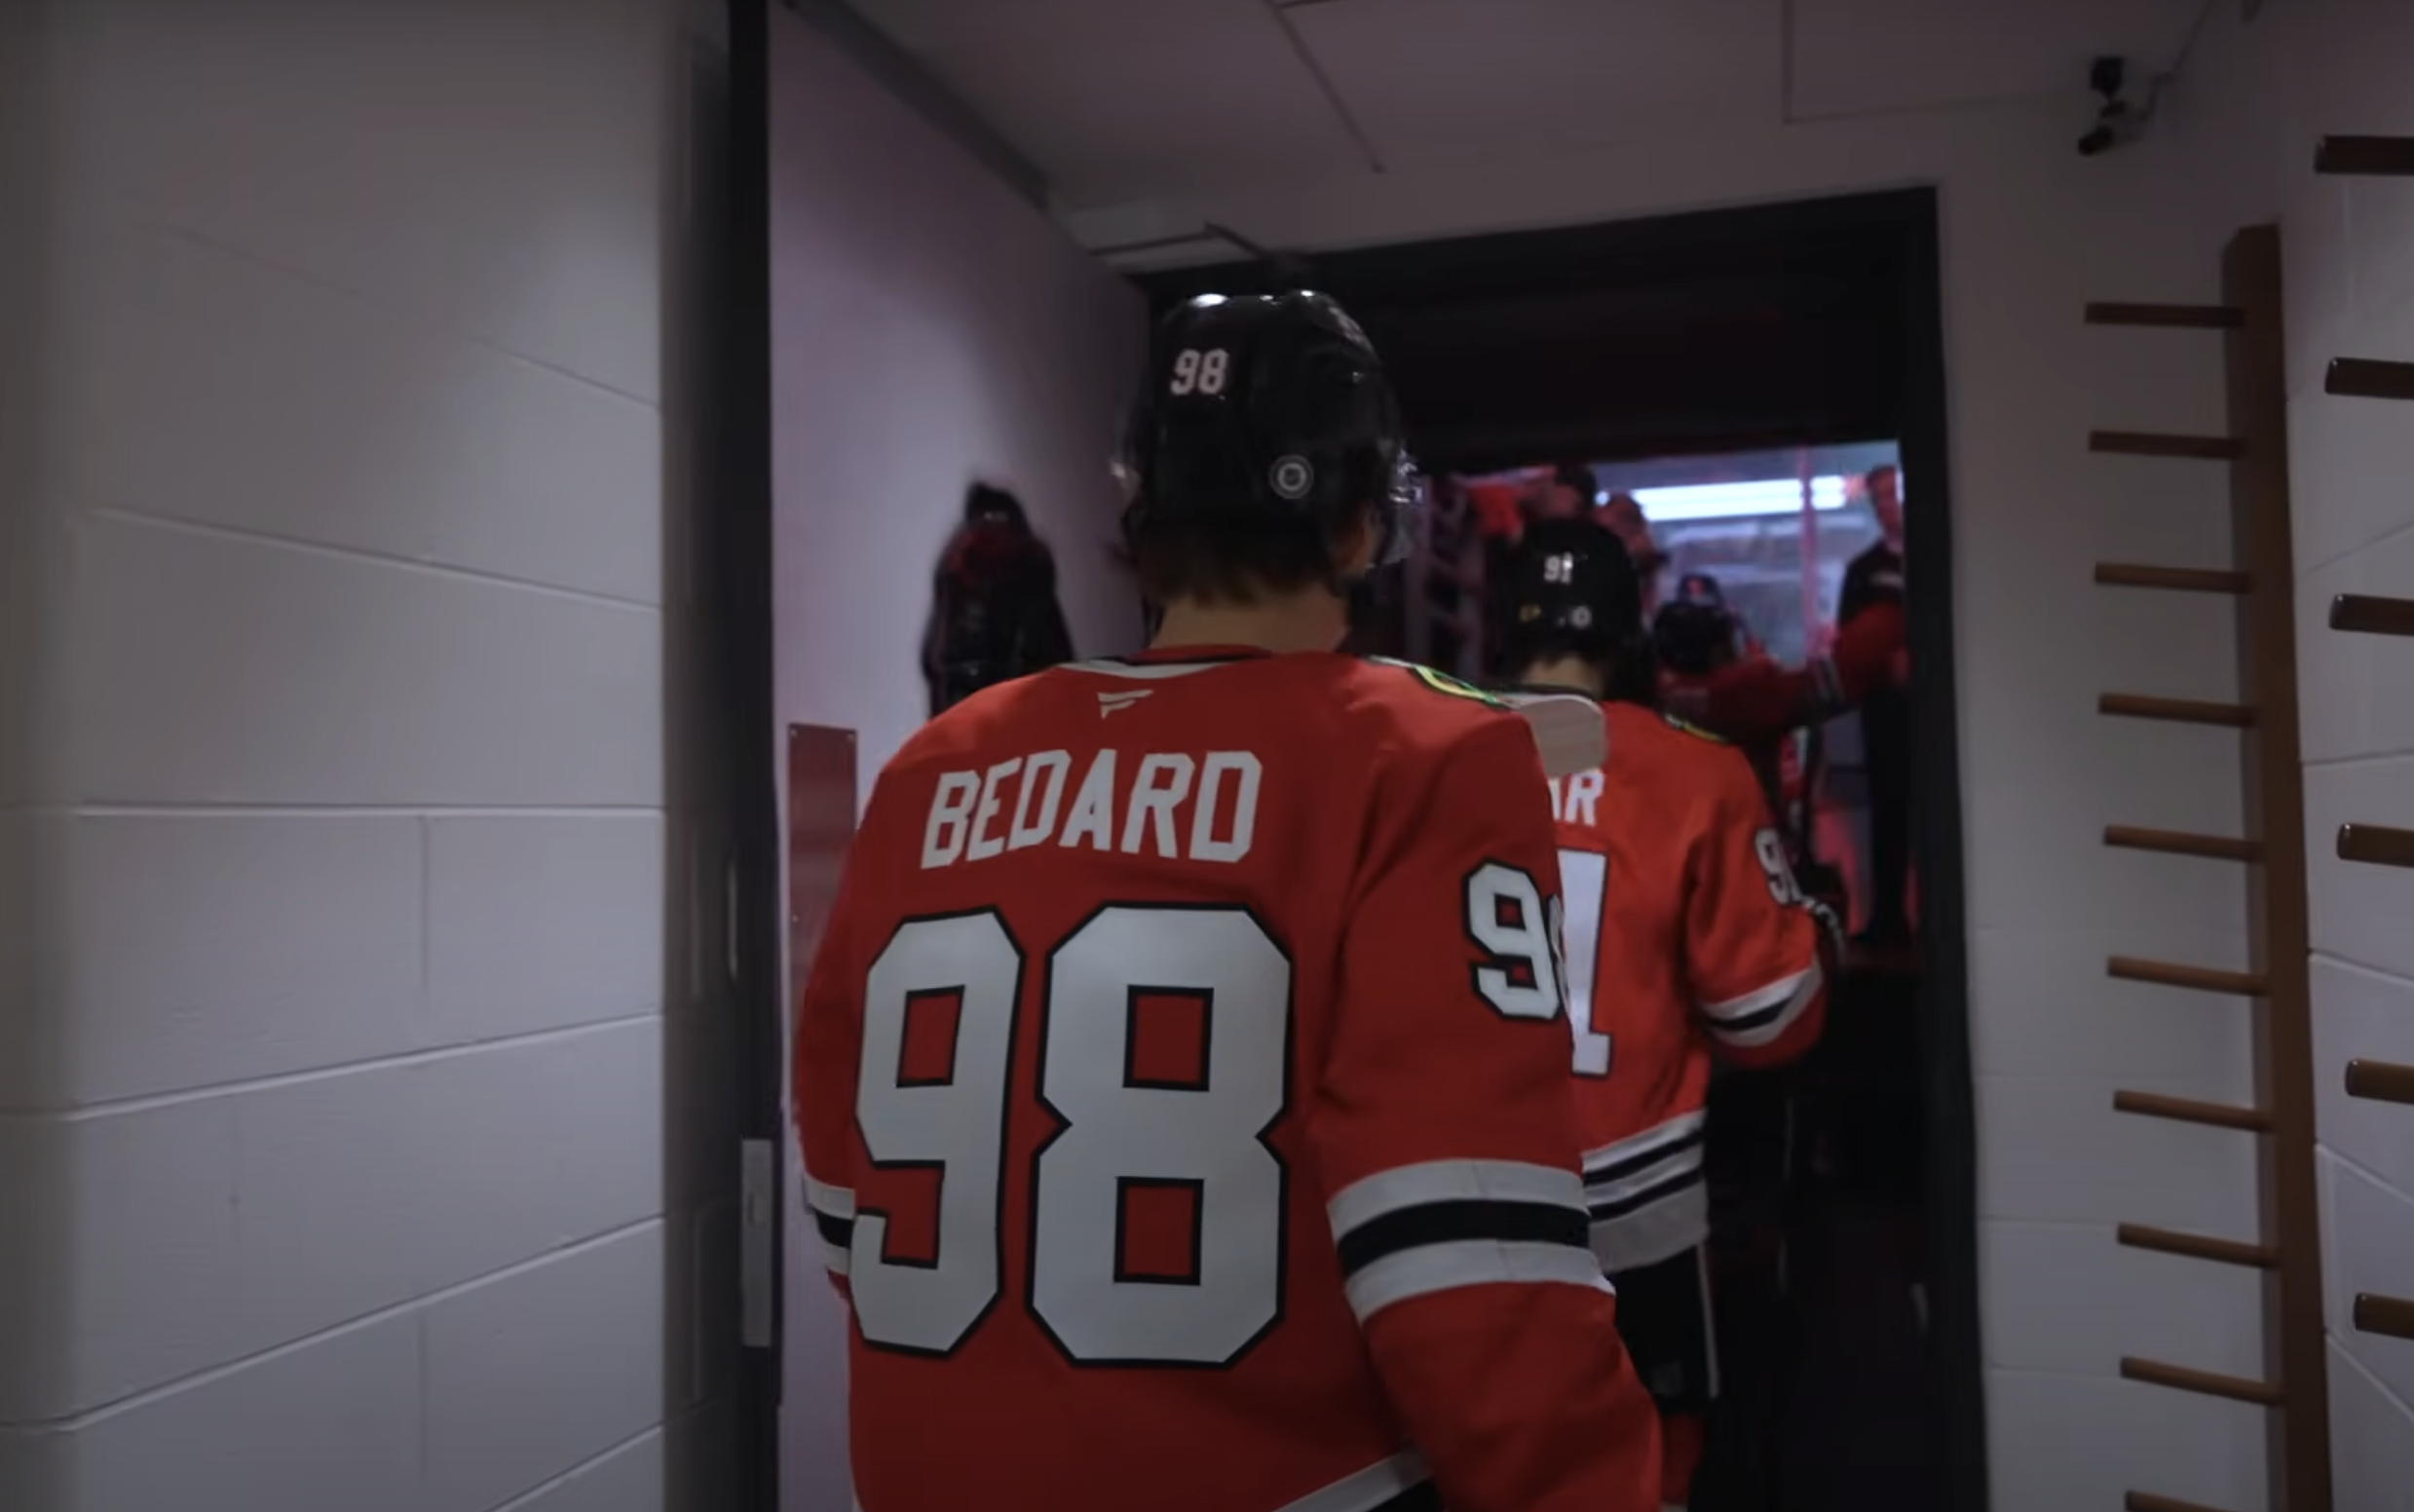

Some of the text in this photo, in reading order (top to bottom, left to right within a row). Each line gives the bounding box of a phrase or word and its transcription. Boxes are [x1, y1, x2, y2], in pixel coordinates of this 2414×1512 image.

[1171, 348, 1229, 395] 98
[920, 749, 1262, 869] BEDARD
[1464, 857, 1570, 1021] 9
[850, 903, 1291, 1370] 98
